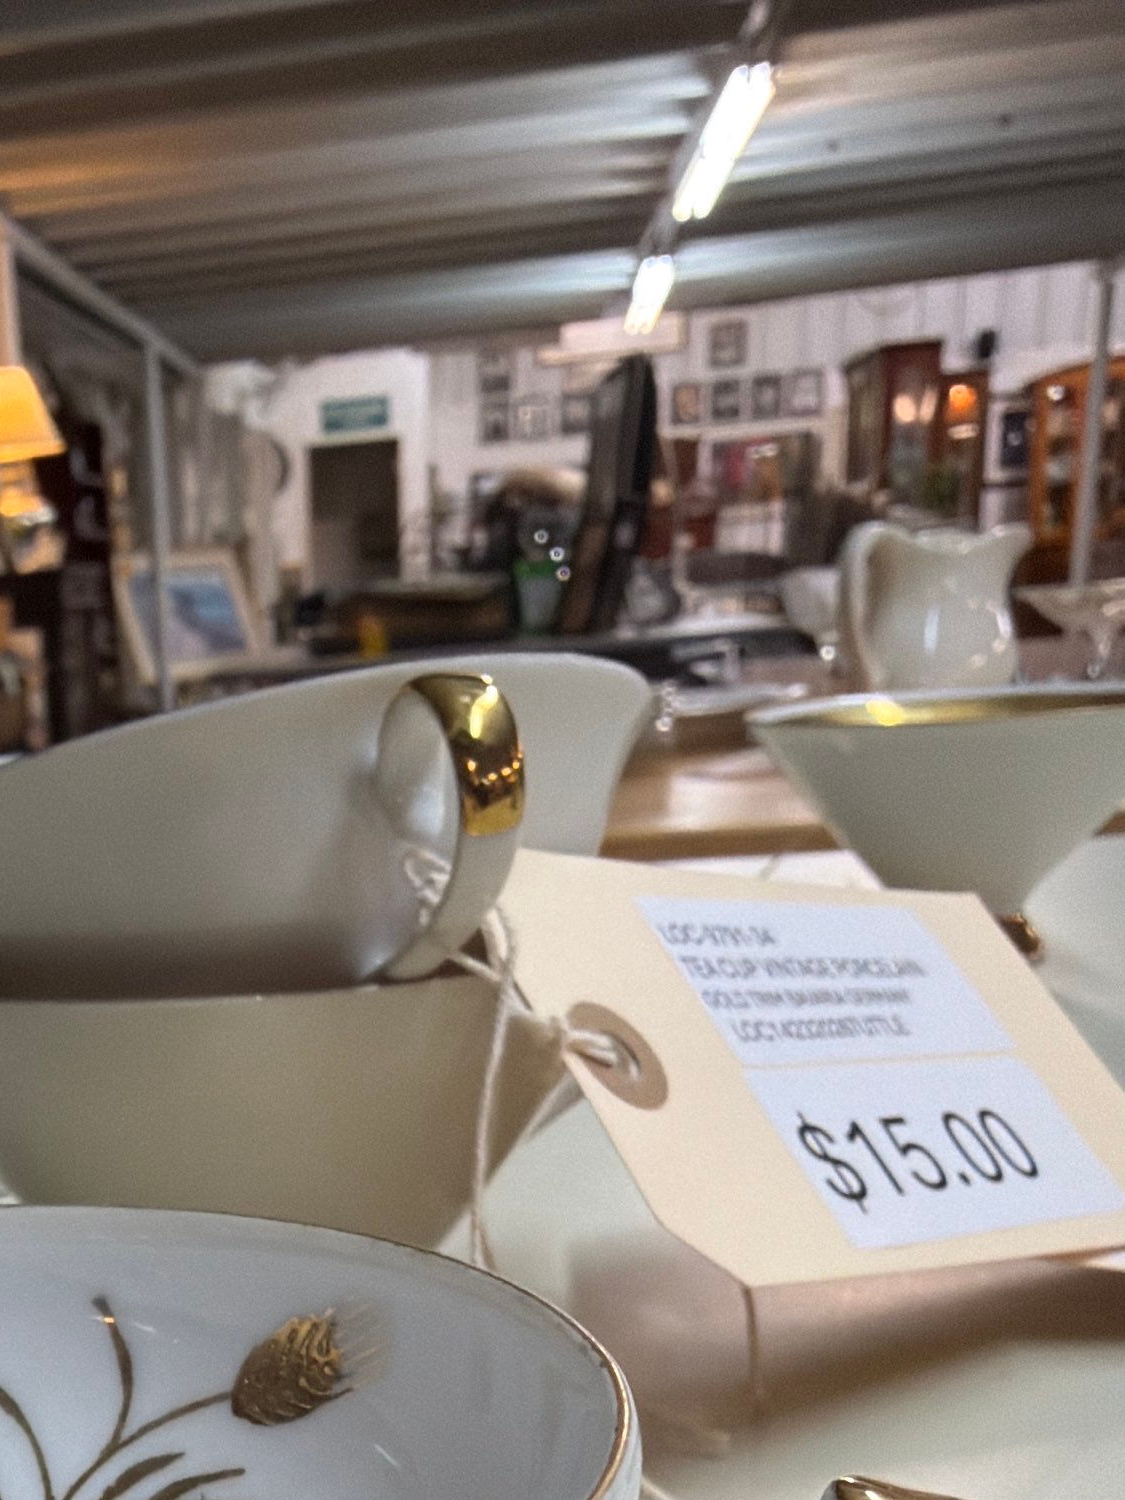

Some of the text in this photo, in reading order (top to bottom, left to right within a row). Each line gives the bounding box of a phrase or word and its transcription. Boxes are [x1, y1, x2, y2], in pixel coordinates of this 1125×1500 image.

[680, 956, 719, 979] TEA
[714, 956, 762, 979] CUP
[757, 956, 833, 978] VINTAGE
[797, 1109, 1039, 1213] $15.00
